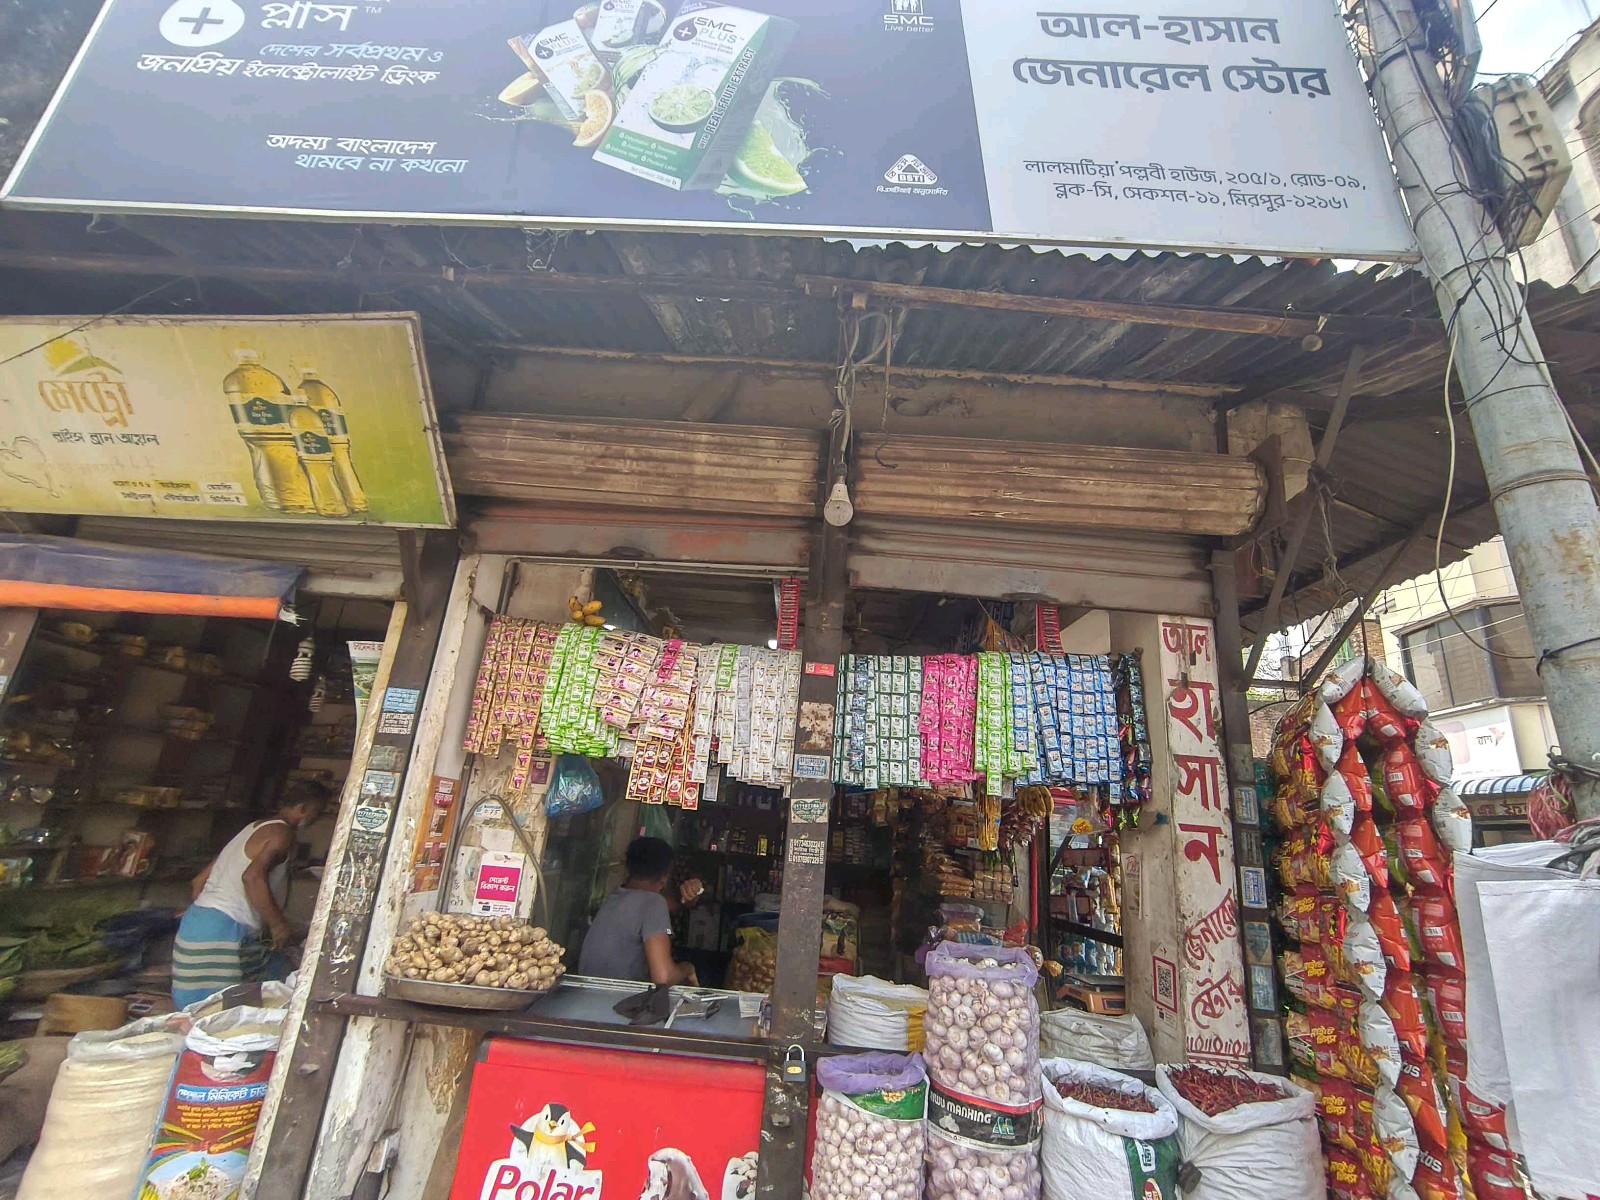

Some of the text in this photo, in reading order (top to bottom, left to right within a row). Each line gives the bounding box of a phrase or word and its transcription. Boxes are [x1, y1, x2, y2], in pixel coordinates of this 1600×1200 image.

[260, 1, 357, 31] প্লাস
[695, 16, 736, 33] SMC
[884, 14, 934, 26] SMC
[699, 27, 738, 43] PLUS
[884, 24, 935, 33] Live better
[1036, 11, 1281, 45] আল-হাসান
[259, 41, 444, 63] দেশের সর্বপ্রথম ও
[136, 51, 245, 76] জনপ্রিয়
[380, 65, 440, 86] ড্রিংক
[1012, 56, 1331, 99] জেনারেল স্টোর
[704, 109, 725, 134] REAL
[717, 83, 738, 110] FRUIT
[730, 47, 756, 85] EXTRACT
[266, 134, 438, 155] অদম্য বাংলাদেশ
[295, 154, 469, 173] থামবে না কখনো
[1023, 158, 1115, 178] লালমাটিয়া
[1119, 163, 1166, 181] পল্লবী
[1168, 165, 1222, 184] হাউজ,
[899, 174, 923, 182] BSTI
[1053, 181, 1118, 200] ব্লক-সি,
[1122, 187, 1226, 206] সেকশন-১১,
[1161, 622, 1211, 662] আল
[250, 1084, 268, 1097] চাউ
[488, 1165, 595, 1200] Polar
